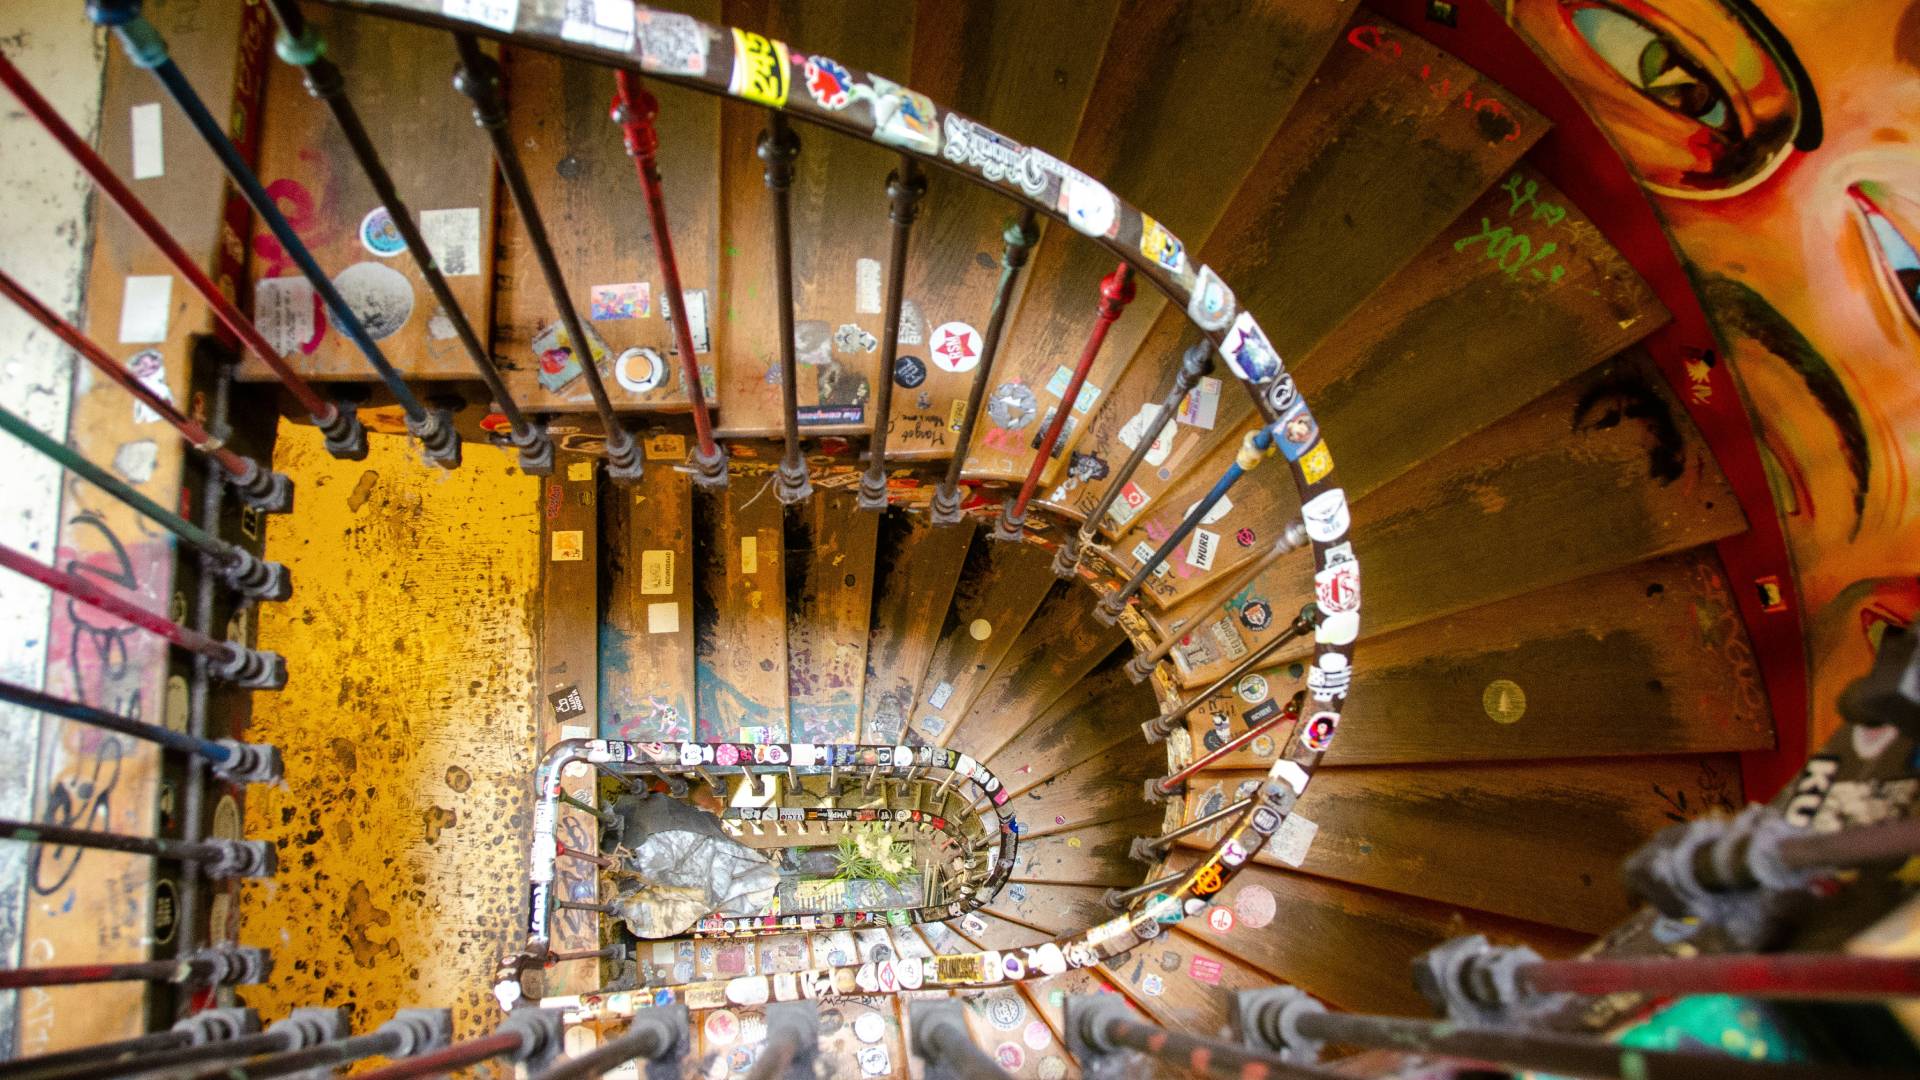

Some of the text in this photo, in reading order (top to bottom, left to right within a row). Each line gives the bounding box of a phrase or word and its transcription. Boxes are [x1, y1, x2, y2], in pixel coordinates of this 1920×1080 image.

[946, 335, 962, 359] RSM
[1195, 532, 1210, 567] THURB
[1219, 617, 1243, 655] RELIGIO
[573, 695, 585, 711] ODIO
